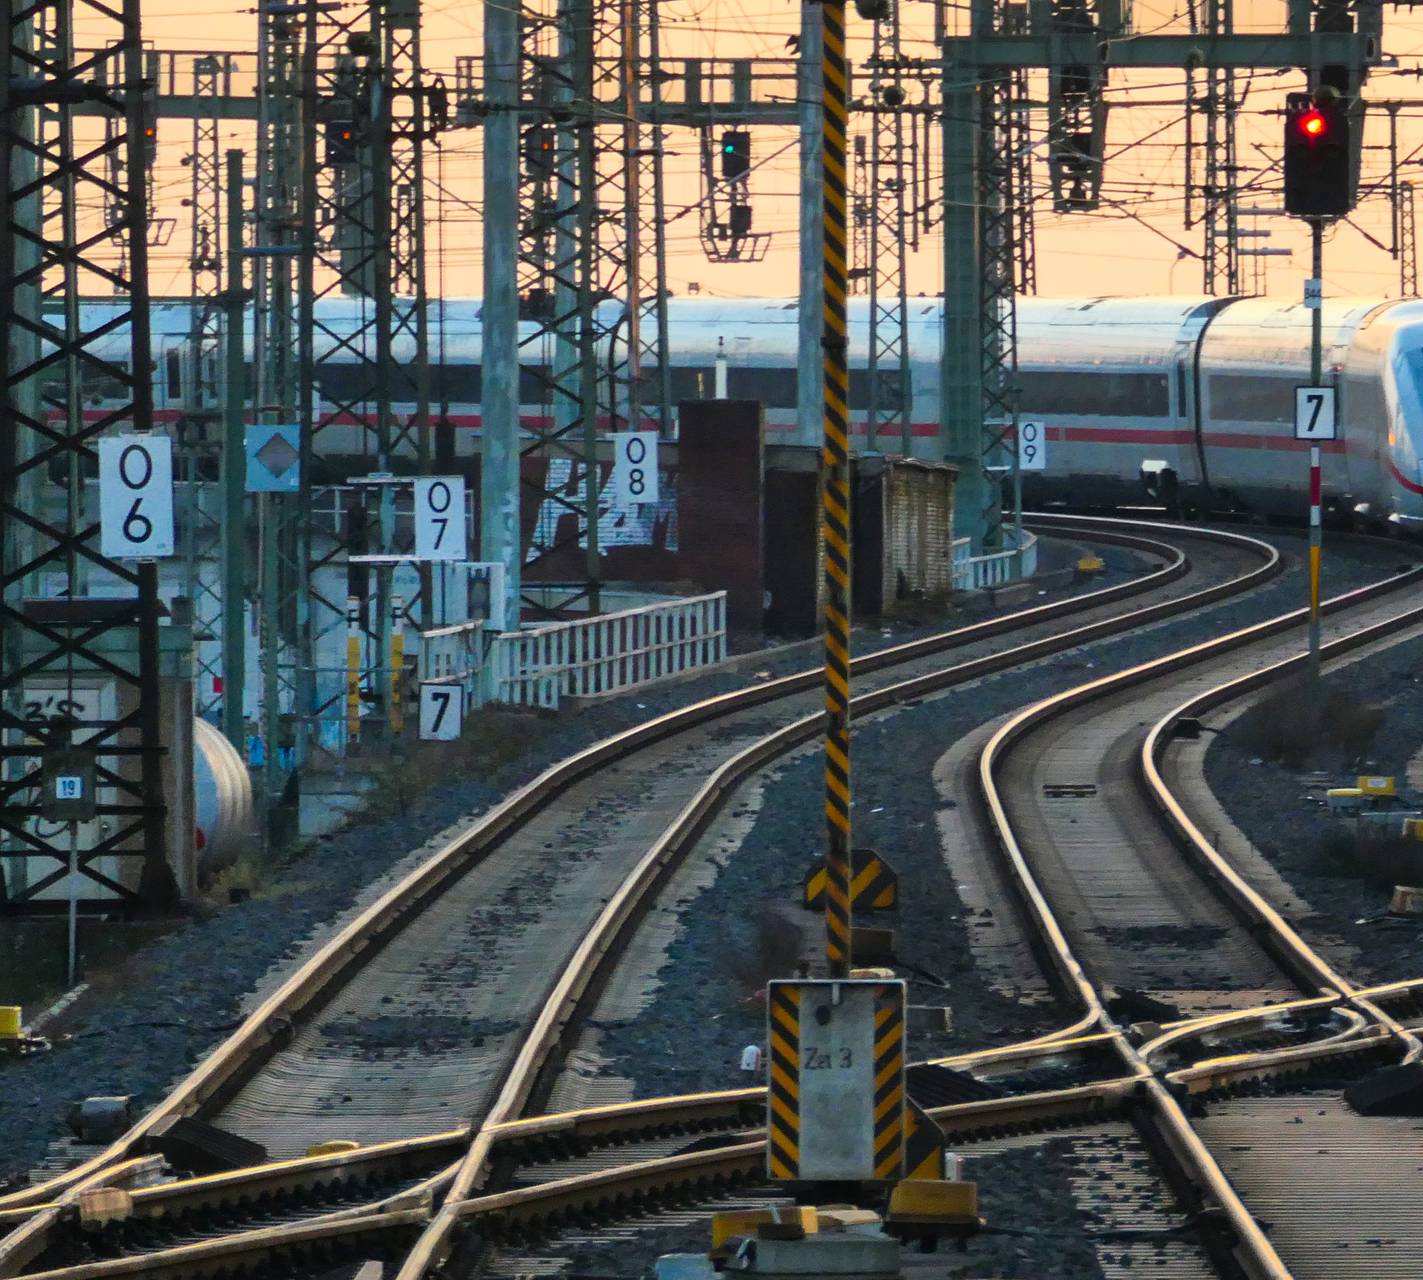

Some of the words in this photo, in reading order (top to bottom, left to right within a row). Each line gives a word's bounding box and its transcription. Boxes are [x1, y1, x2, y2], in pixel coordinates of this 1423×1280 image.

[1306, 394, 1325, 433] 7
[431, 691, 451, 733] 7
[61, 779, 77, 797] 19
[840, 1046, 852, 1069] 3
